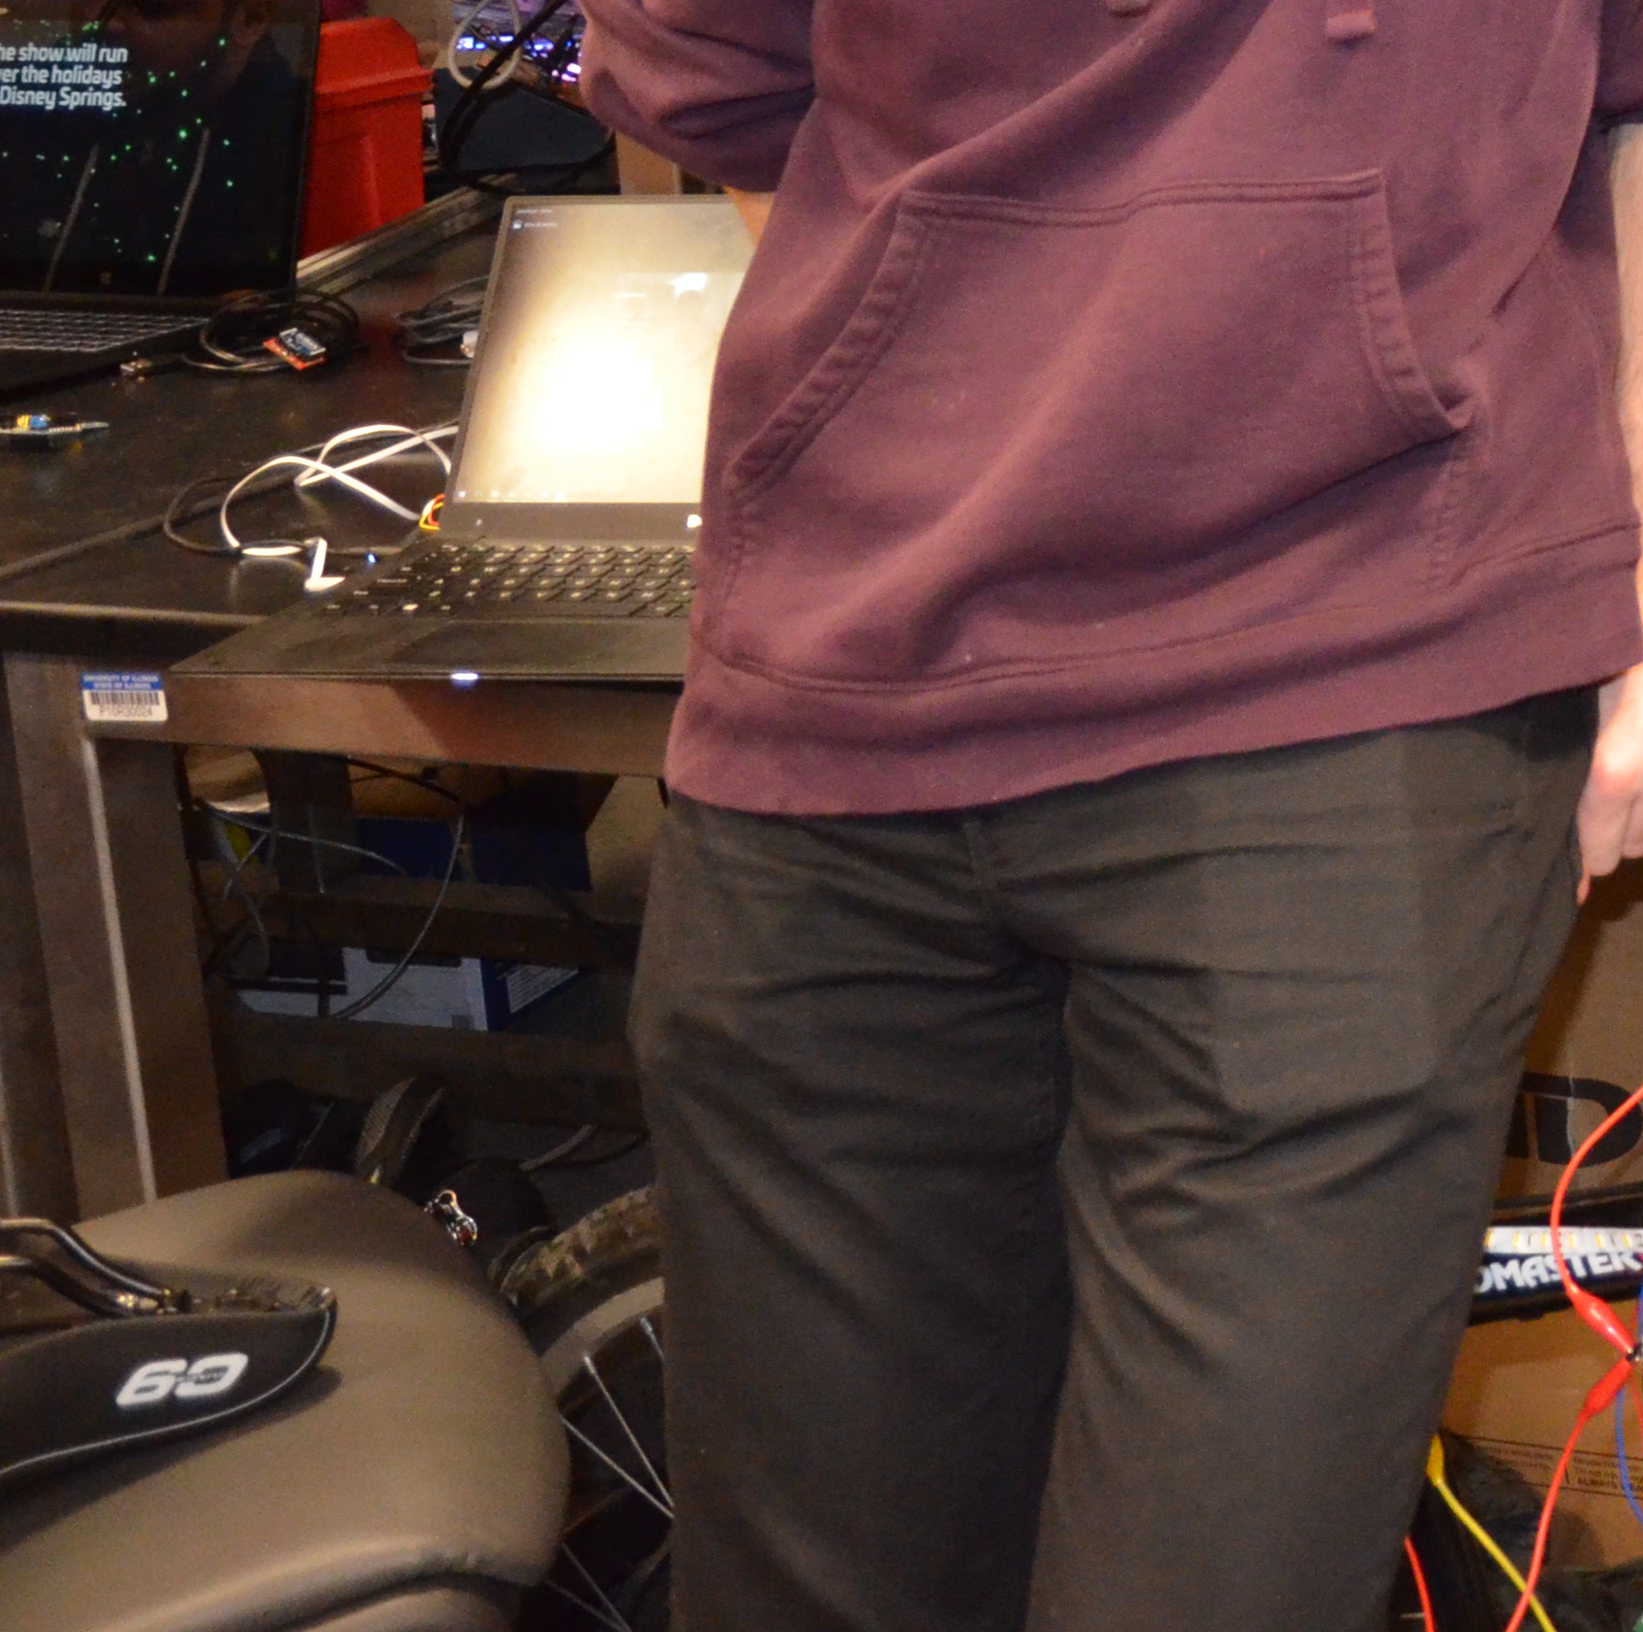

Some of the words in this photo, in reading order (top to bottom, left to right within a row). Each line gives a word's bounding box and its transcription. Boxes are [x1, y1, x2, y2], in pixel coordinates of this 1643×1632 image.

[18, 42, 63, 62] show
[65, 42, 97, 62] will
[99, 47, 128, 62] run
[21, 64, 49, 85] the
[51, 65, 122, 88] holidays
[0, 85, 57, 111] Disney
[59, 86, 127, 111] Springs.
